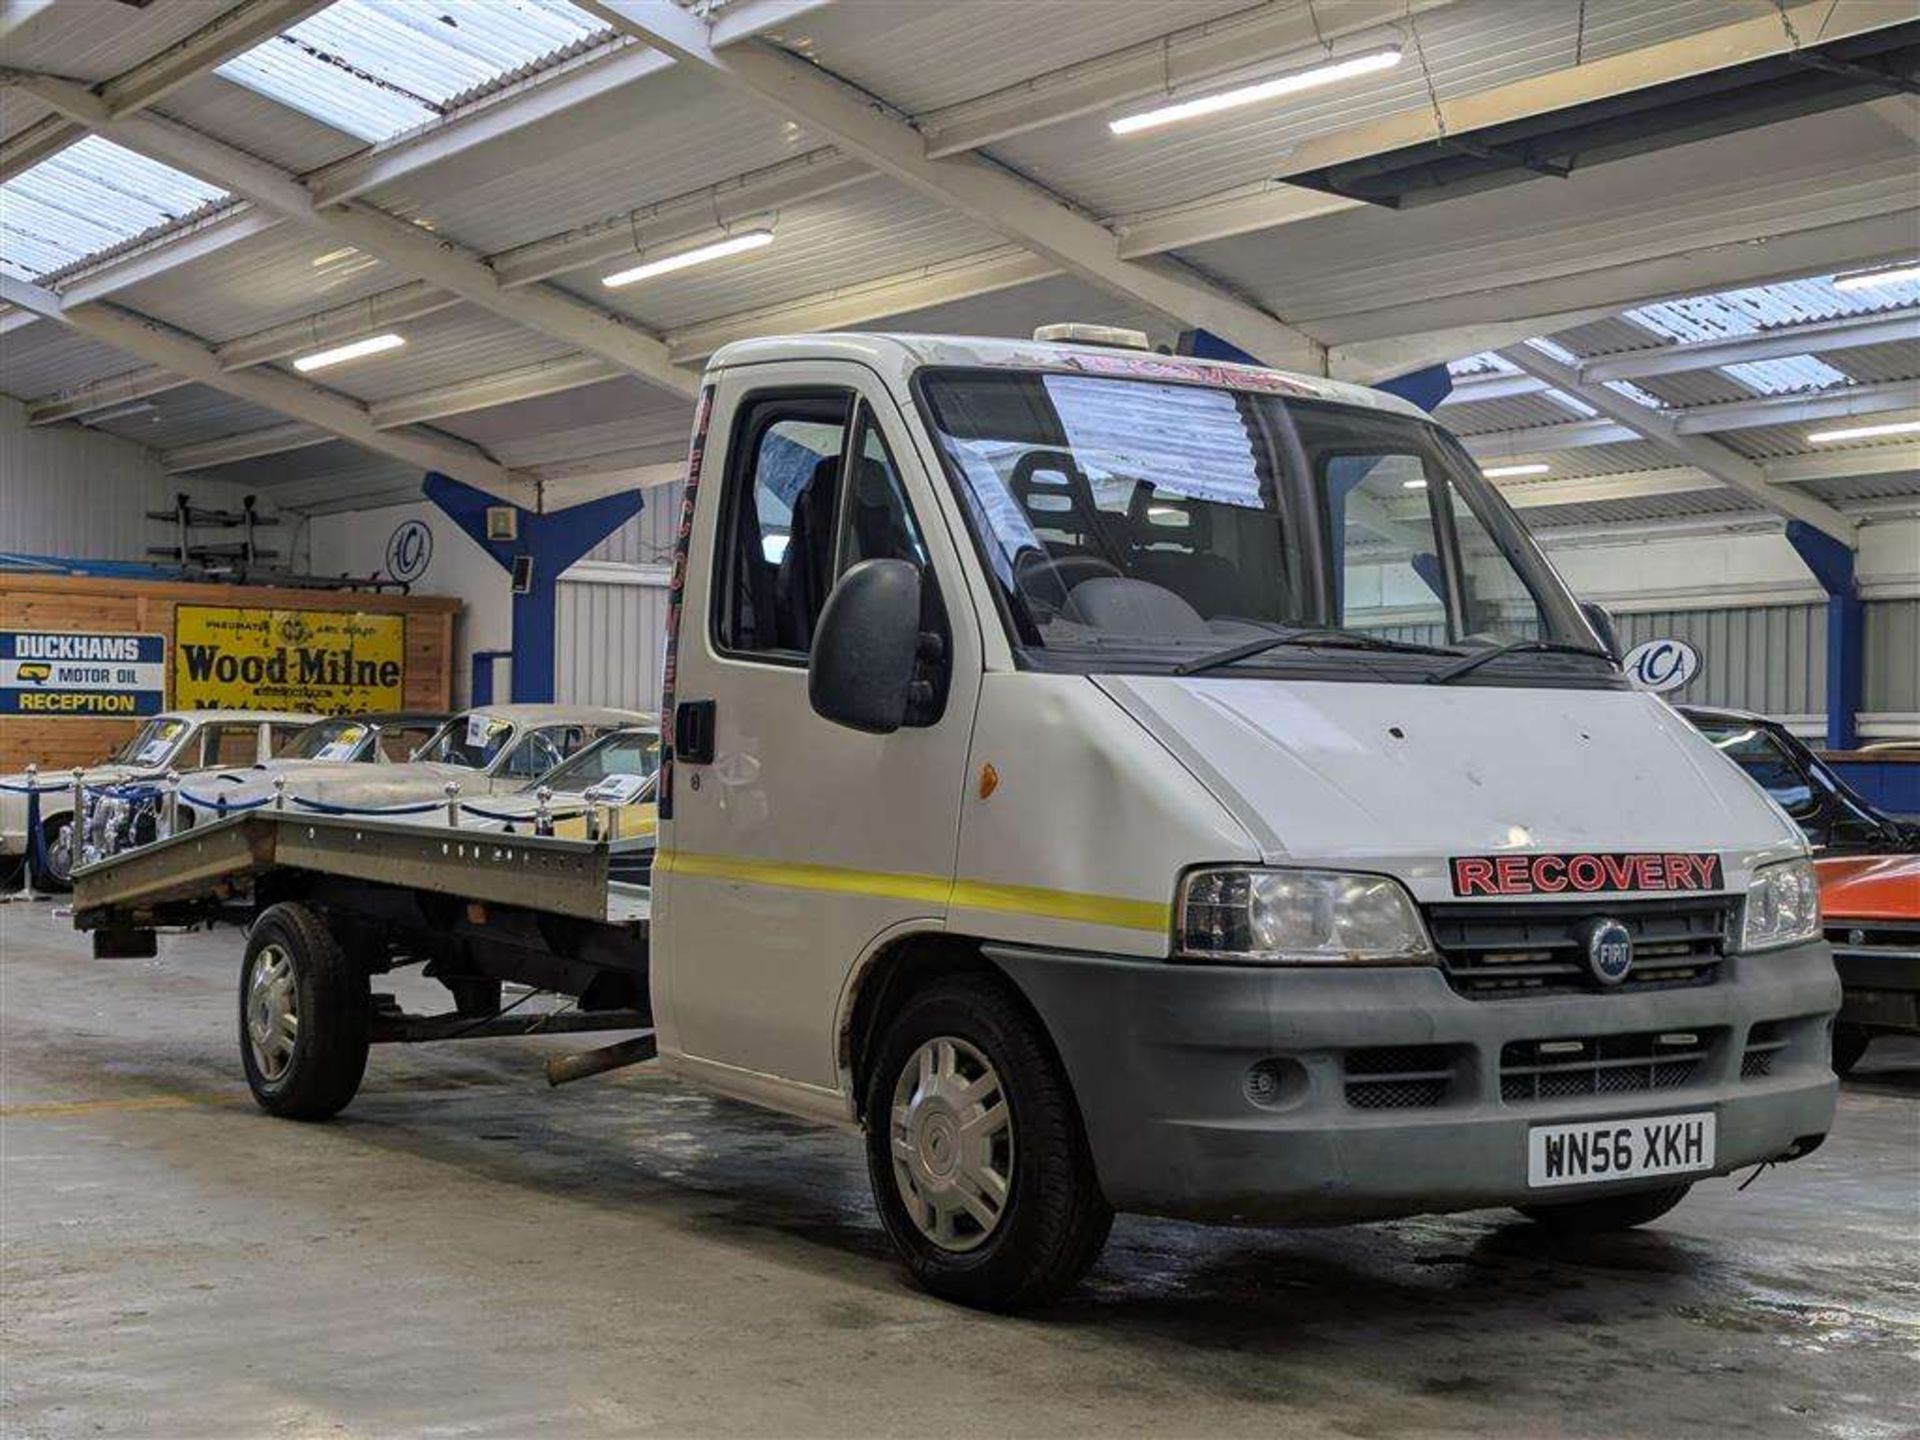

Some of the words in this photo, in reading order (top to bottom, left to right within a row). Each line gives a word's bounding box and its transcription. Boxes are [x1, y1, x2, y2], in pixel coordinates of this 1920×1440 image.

[15, 635, 140, 660] DUCKHAMS
[58, 668, 109, 683] MOTOR
[117, 669, 138, 684] OIL
[19, 693, 135, 711] RECEPTION
[1456, 854, 1717, 895] RECOVERY
[1601, 943, 1628, 964] FIAT
[1545, 1128, 1632, 1178] WN56
[1643, 1121, 1703, 1169] XKH
